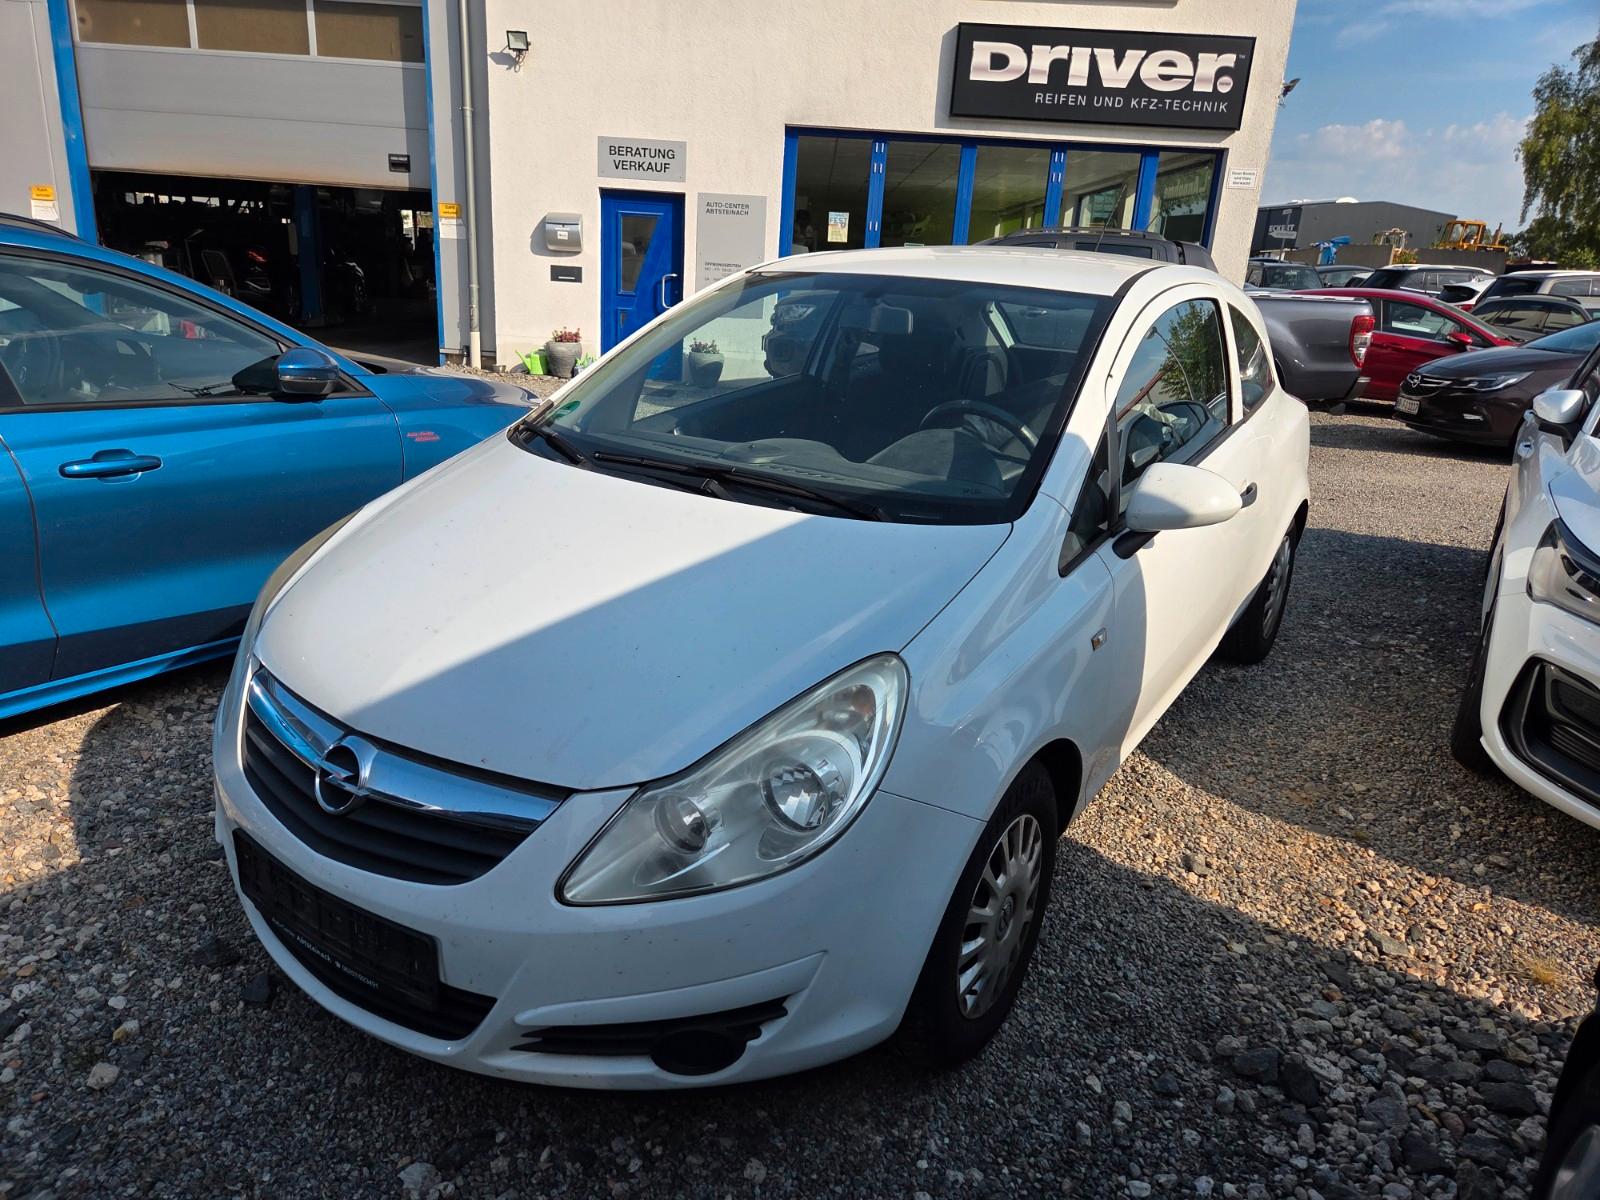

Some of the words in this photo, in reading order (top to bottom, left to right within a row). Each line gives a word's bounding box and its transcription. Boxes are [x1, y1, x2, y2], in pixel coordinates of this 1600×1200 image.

[1034, 92, 1087, 106] REIFEN
[1093, 95, 1124, 108] UND
[1130, 98, 1229, 113] KFZ-TECHNIK
[609, 145, 676, 160] BERATUNG
[613, 159, 671, 173] VERKAUF
[705, 201, 750, 210] AUTO-CENTER
[705, 208, 749, 217] ABTSTEINACH
